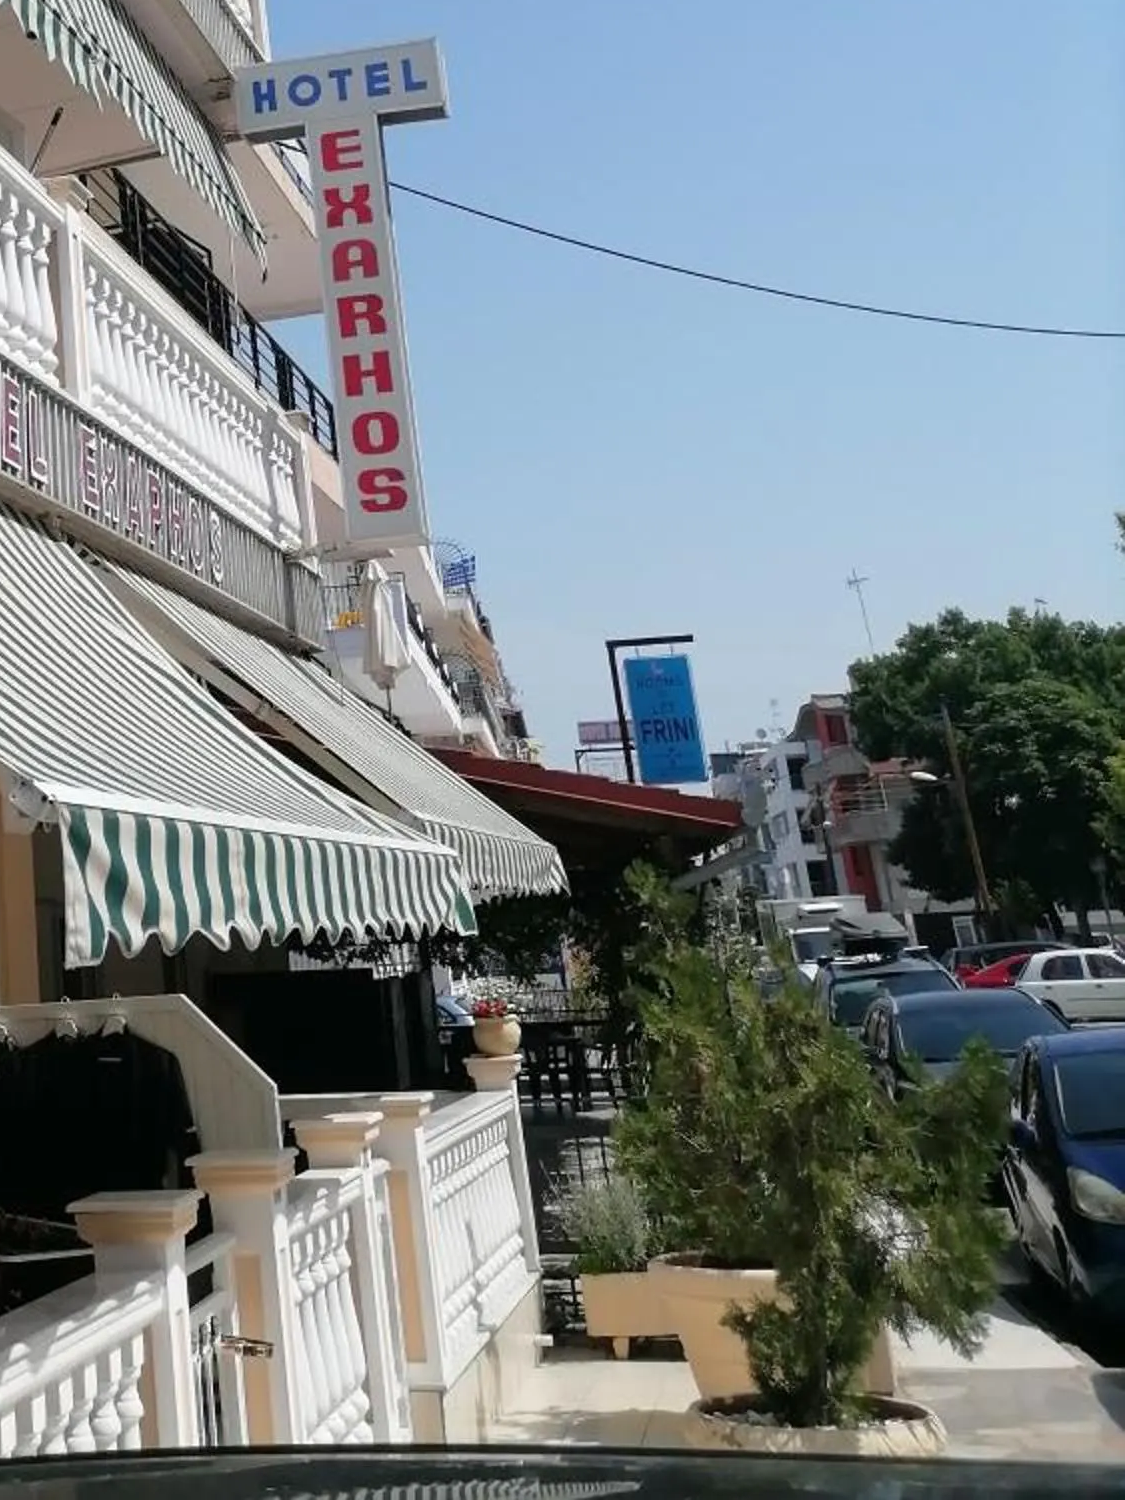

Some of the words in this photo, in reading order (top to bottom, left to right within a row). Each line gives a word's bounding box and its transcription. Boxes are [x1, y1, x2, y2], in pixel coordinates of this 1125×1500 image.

[253, 58, 427, 114] HOTEL
[320, 129, 408, 513] EXARHOS
[640, 716, 696, 744] FRINI
